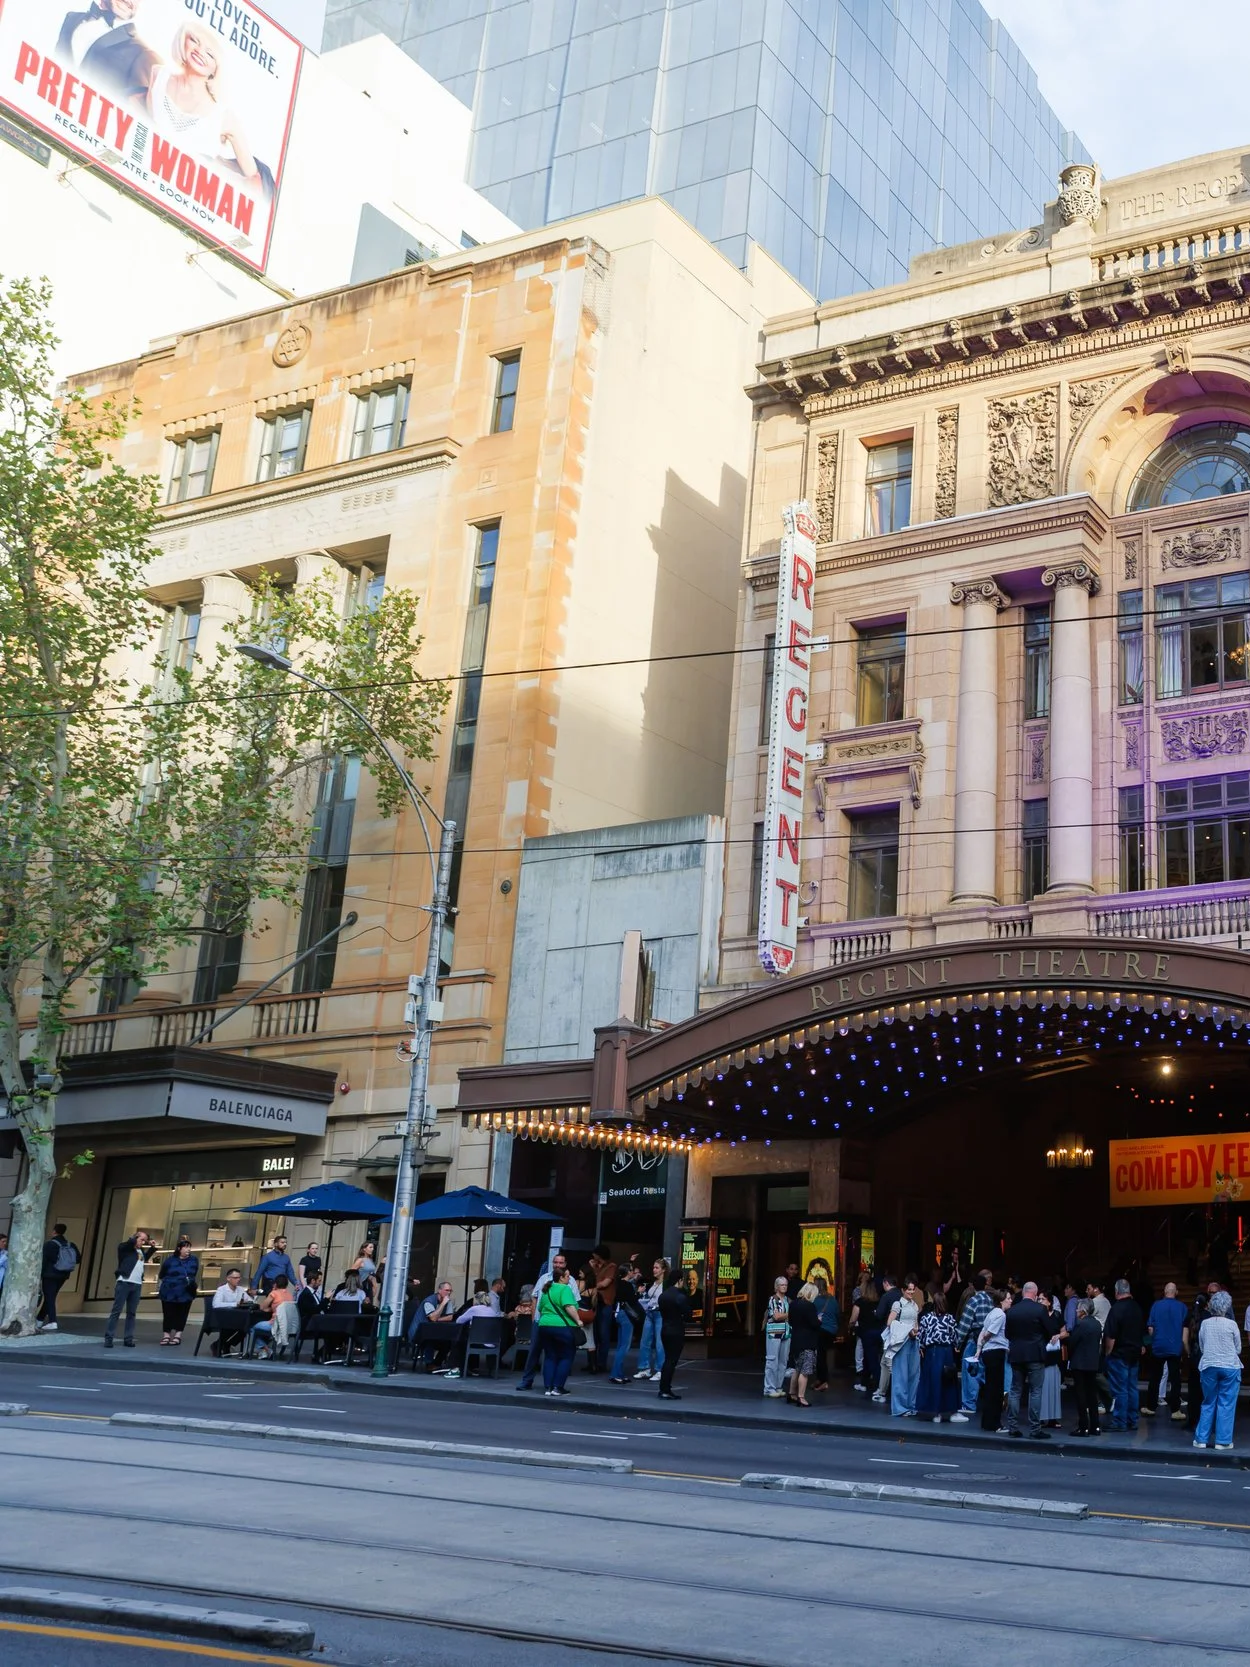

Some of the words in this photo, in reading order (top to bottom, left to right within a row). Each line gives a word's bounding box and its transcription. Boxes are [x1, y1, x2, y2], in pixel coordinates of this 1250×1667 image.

[229, 27, 279, 79] ADORE.
[14, 41, 134, 153] PRETTY
[54, 113, 101, 148] REGENT
[103, 145, 149, 181] ATRE
[159, 183, 189, 208] BOOK
[191, 204, 215, 224] NOW
[151, 132, 255, 237] WOMAN
[1119, 191, 1165, 221] THE
[775, 551, 814, 928] REGENT
[808, 957, 952, 1012] REGENT
[992, 948, 1172, 982] THEATRE
[208, 1098, 293, 1122] BALENCIAGA
[1115, 1143, 1216, 1193] COMEDY
[608, 1187, 641, 1197] Seafood
[682, 1251, 705, 1261] GLEESON
[683, 1242, 695, 1252] TOM
[719, 1253, 731, 1267] TOM
[718, 1266, 741, 1280] GLEESON
